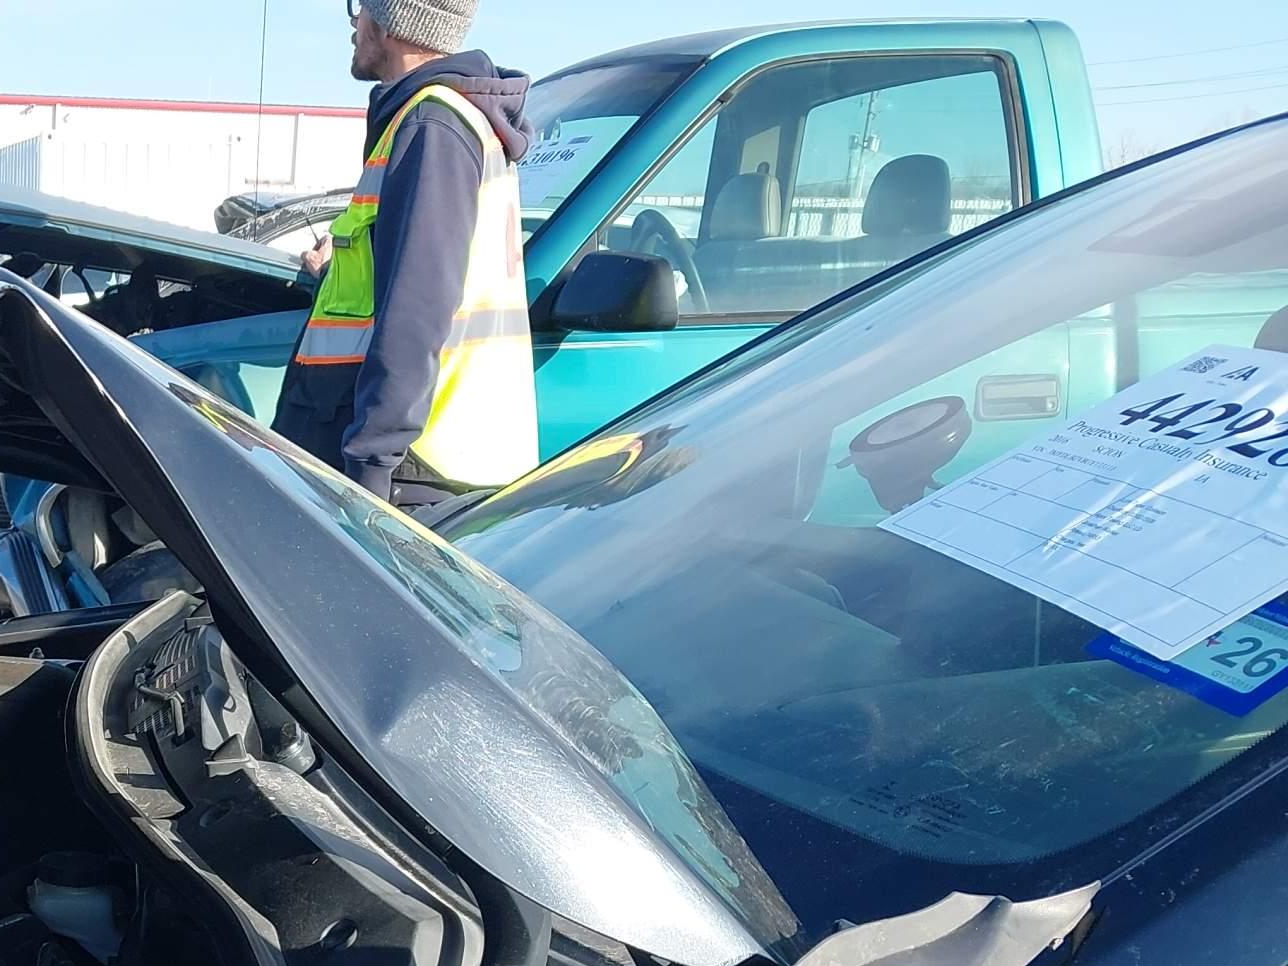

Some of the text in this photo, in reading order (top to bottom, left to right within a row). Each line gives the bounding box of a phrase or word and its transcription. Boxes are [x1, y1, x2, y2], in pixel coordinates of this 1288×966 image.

[516, 148, 578, 167] 310196
[1067, 420, 1140, 445] Progressive
[1138, 437, 1193, 462] Casualty
[1193, 448, 1268, 481] Insurance
[1119, 393, 1288, 467] 44292
[1210, 637, 1288, 678] 26
